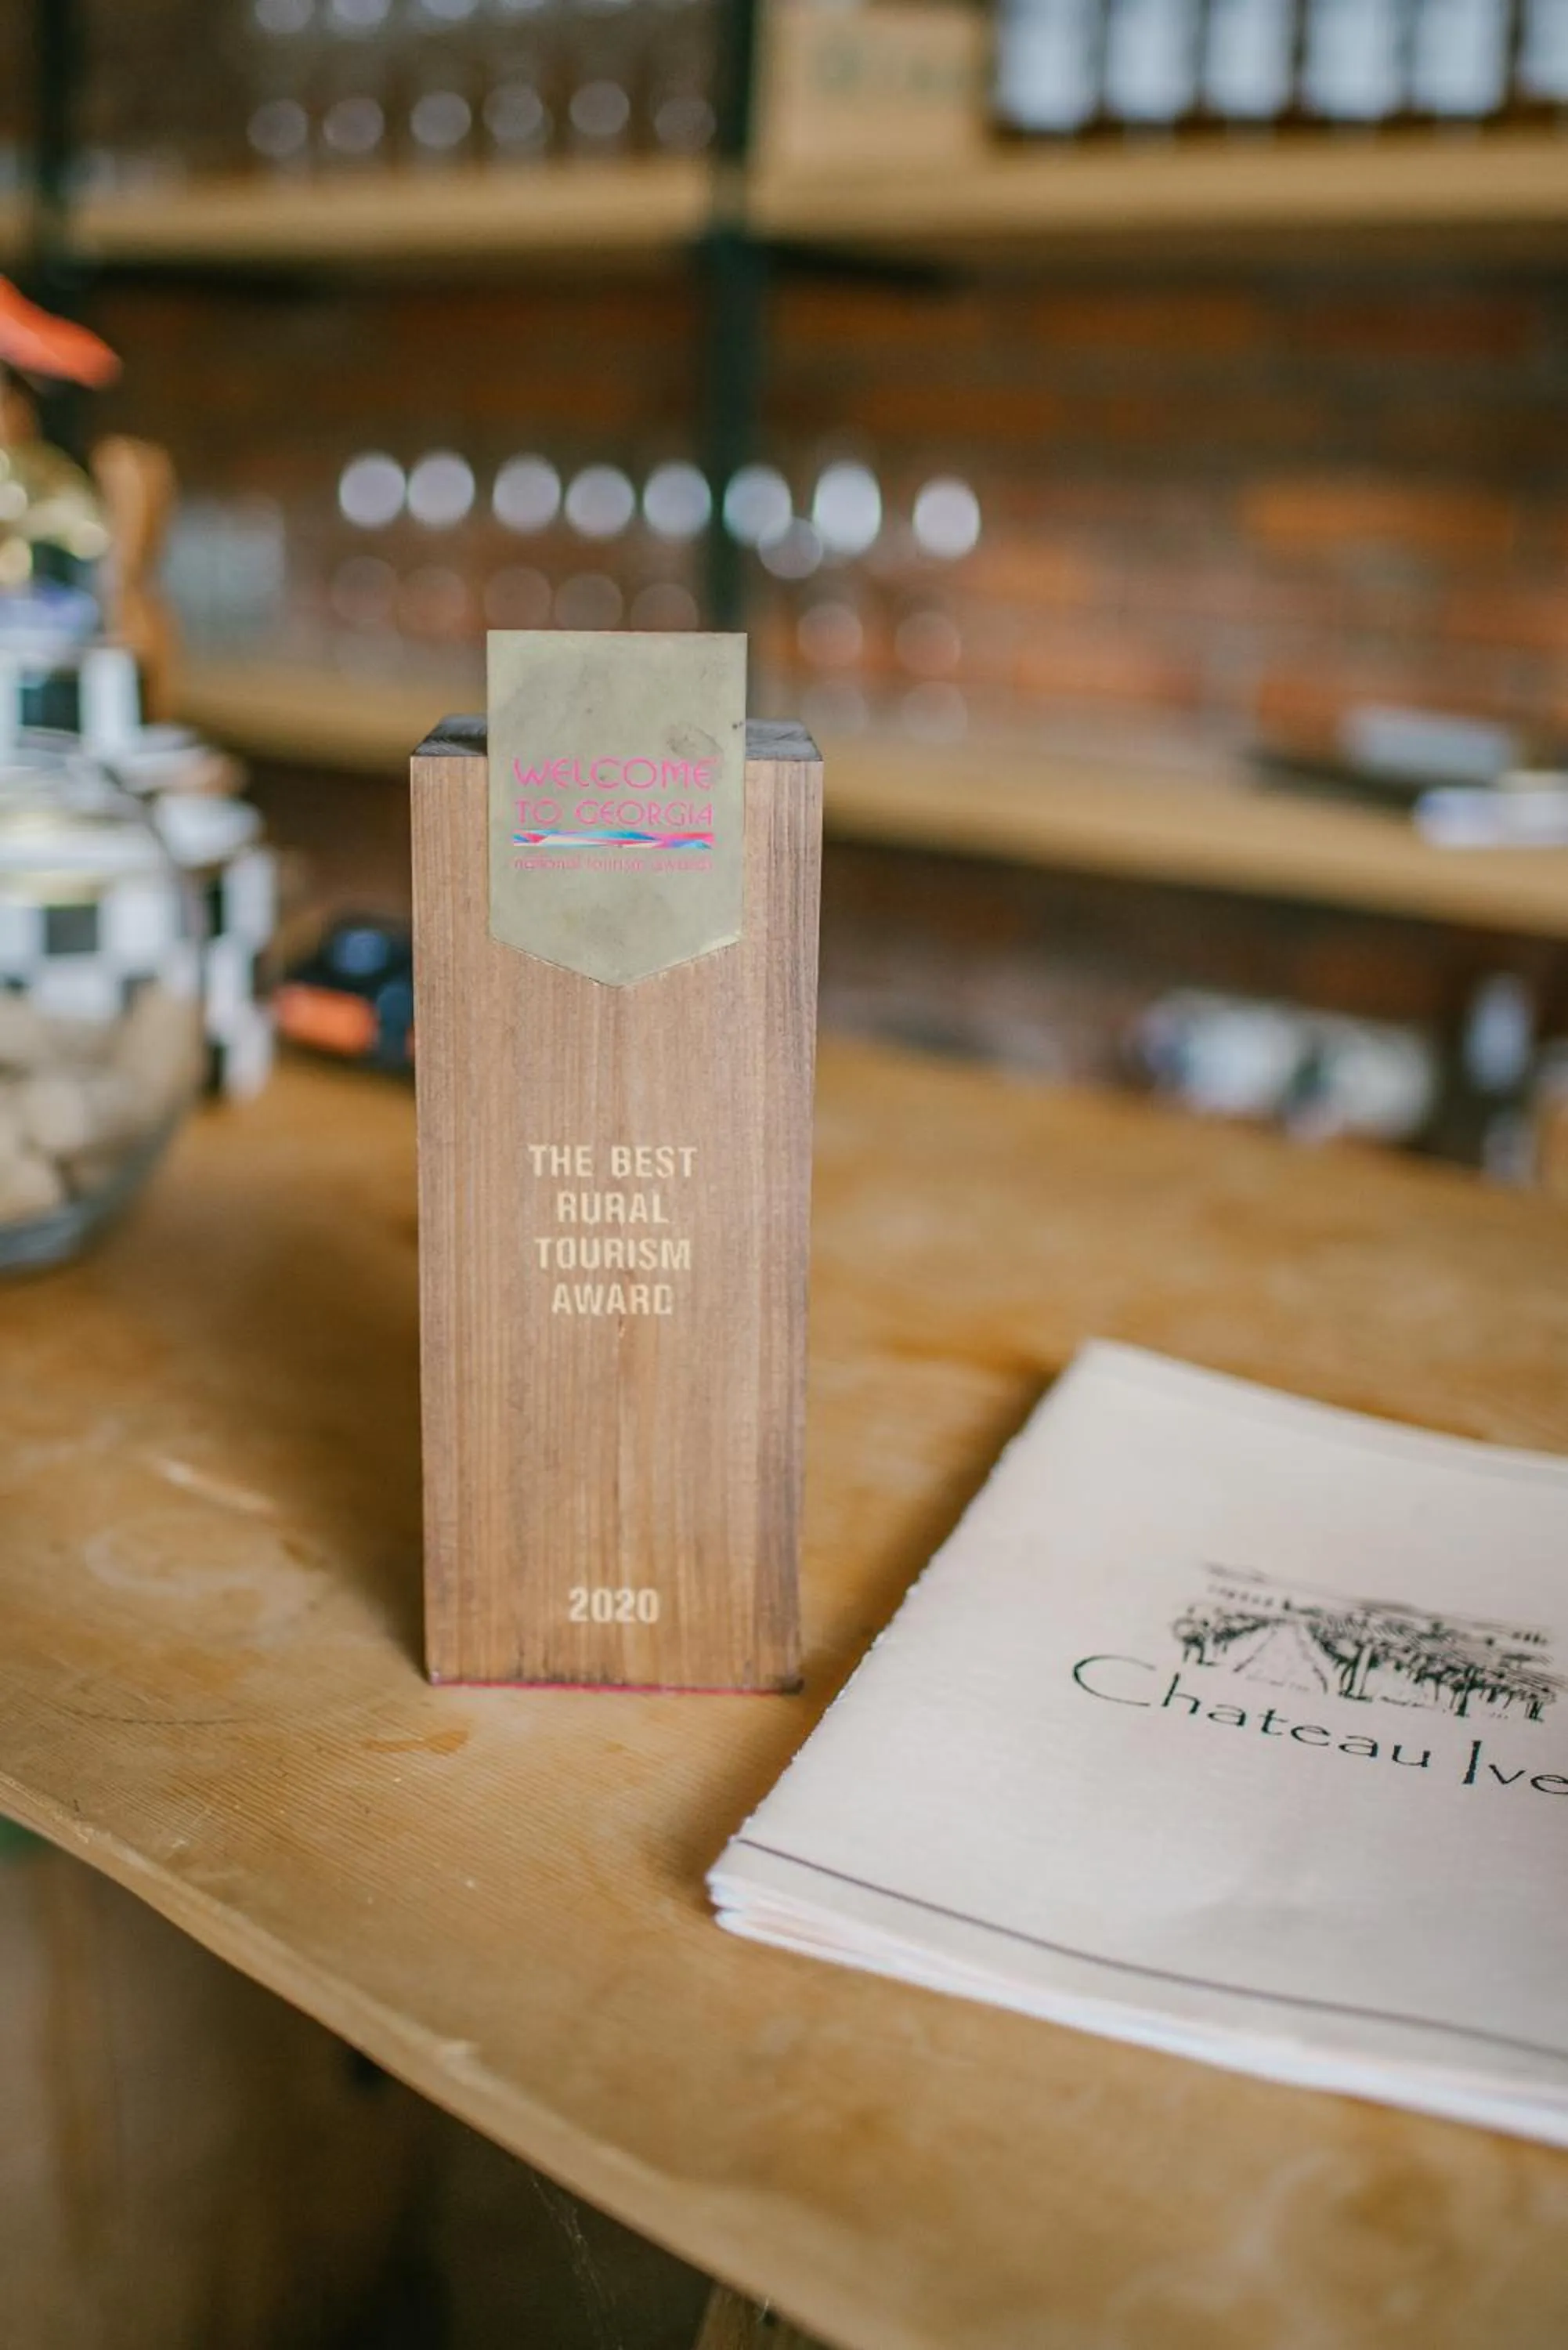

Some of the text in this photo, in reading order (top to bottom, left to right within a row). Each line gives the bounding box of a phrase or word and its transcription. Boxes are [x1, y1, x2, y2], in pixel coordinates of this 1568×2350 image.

[514, 755, 717, 790] WELCOME
[515, 799, 713, 826] TO GEORGIA
[528, 1144, 697, 1178] THE BEST
[557, 1191, 670, 1225] RURAL
[535, 1238, 692, 1271] TOURISM
[551, 1282, 674, 1316] AWARD
[569, 1586, 659, 1623] 2020
[1073, 1654, 1431, 1769] Chateau
